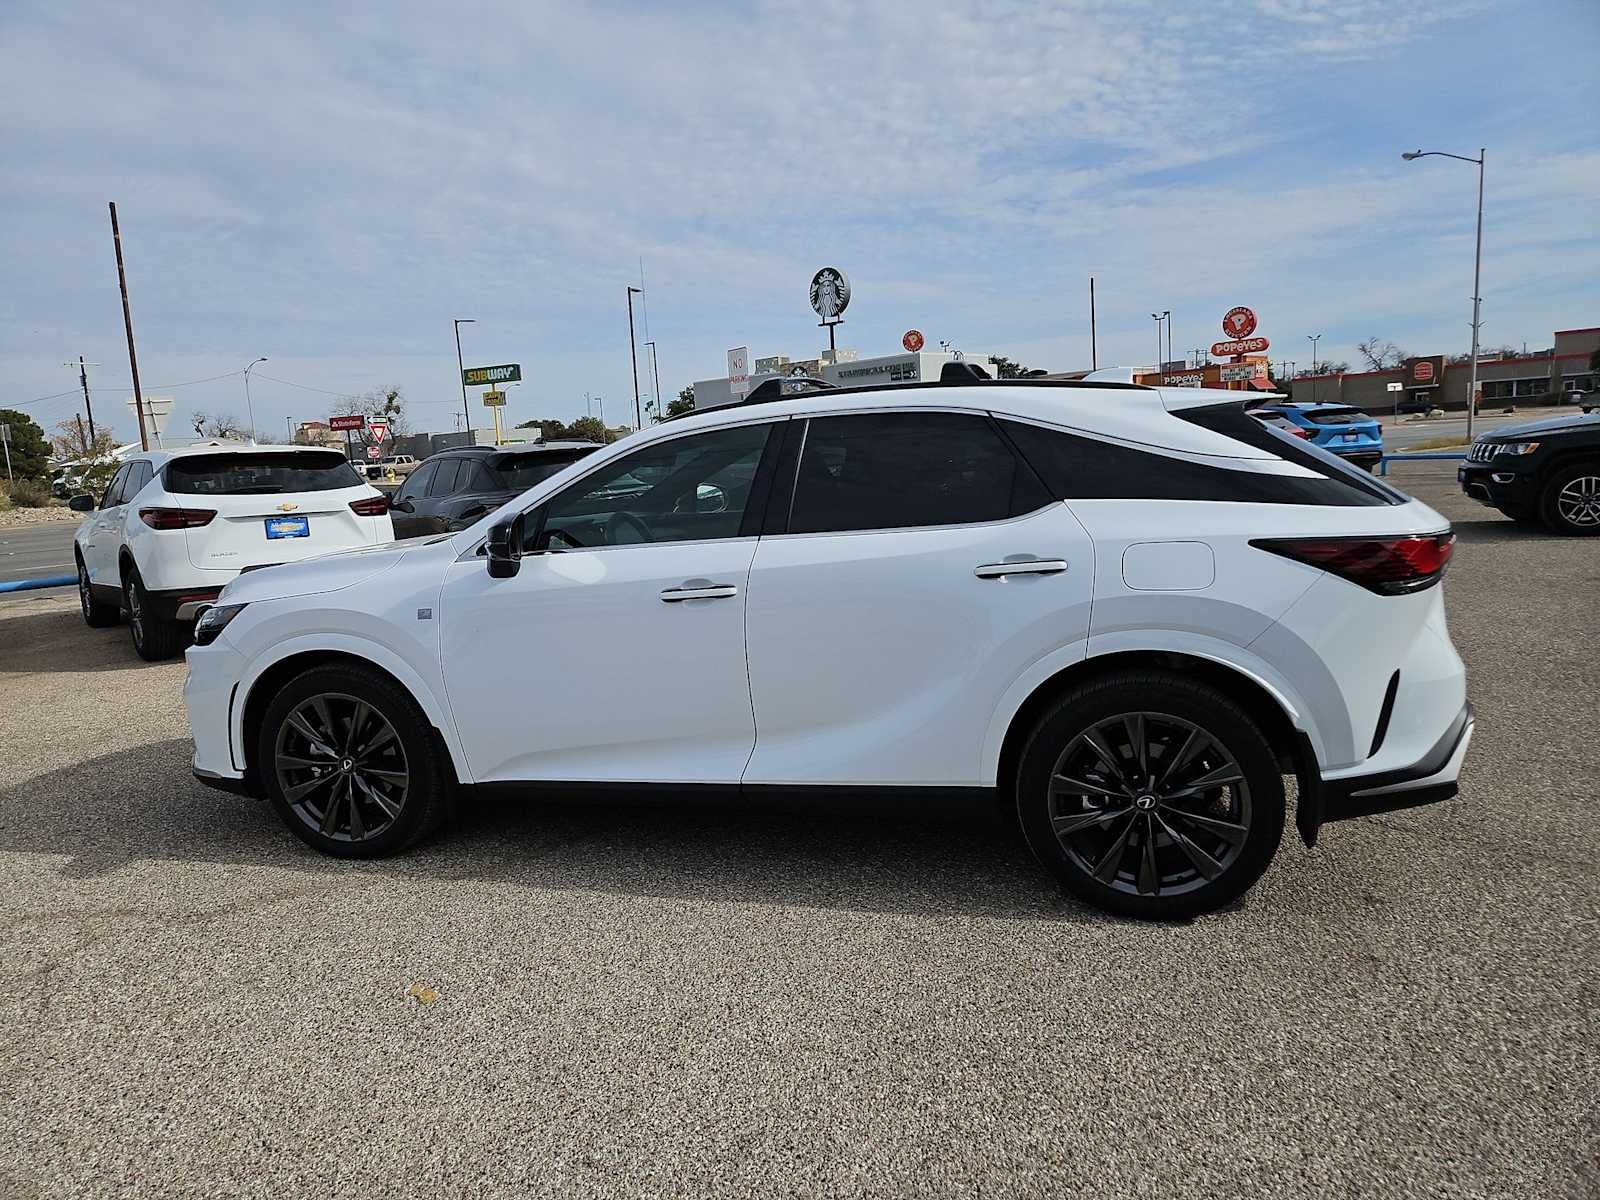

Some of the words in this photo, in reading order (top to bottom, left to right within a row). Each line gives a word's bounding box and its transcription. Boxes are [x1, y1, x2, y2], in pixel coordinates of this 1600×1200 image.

[1215, 339, 1264, 353] POPEYES
[733, 358, 743, 369] NO
[467, 366, 514, 382] SUBWAY
[729, 374, 749, 385] PARKING
